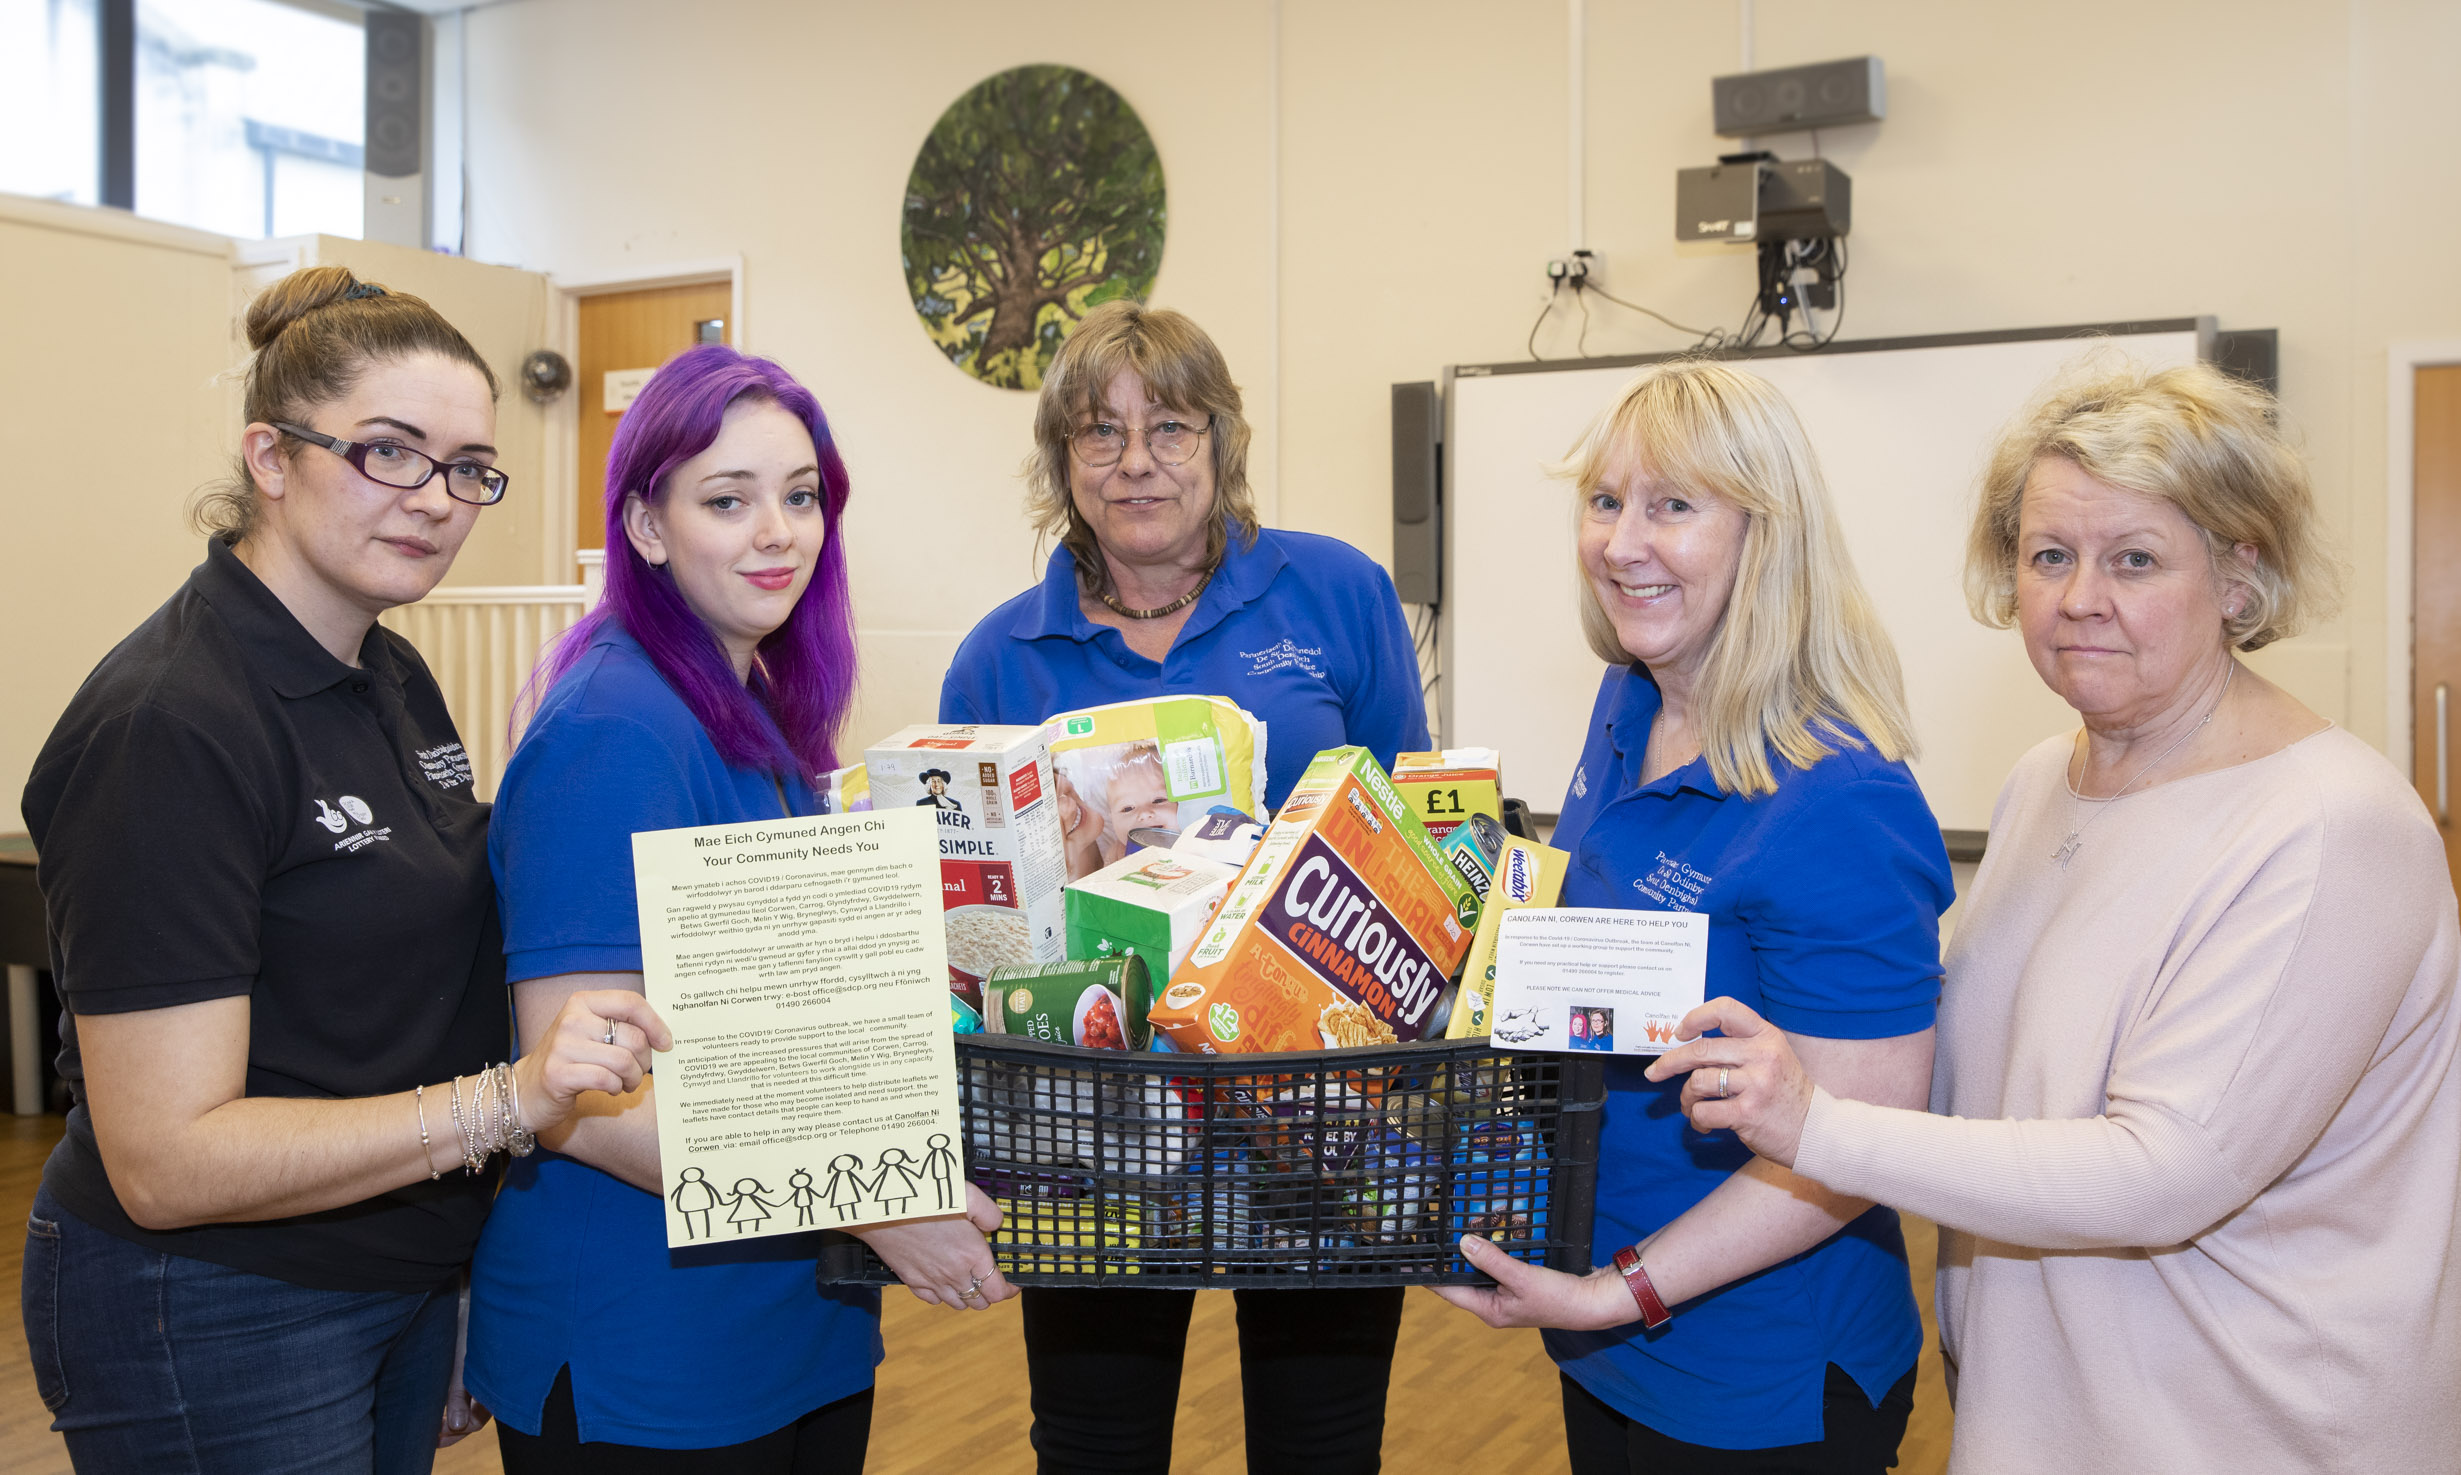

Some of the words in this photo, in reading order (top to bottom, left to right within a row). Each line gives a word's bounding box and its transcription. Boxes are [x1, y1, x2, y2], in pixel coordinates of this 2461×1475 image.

[1427, 789, 1465, 814] £1
[334, 832, 364, 851] ARIENNIR
[348, 836, 376, 853] LOTTERY
[694, 836, 721, 848] Mae
[724, 832, 753, 845] Eich
[755, 826, 817, 844] Cymuned
[820, 824, 861, 837] Angen
[864, 819, 885, 832] Chi
[702, 856, 733, 867] Your
[736, 848, 809, 864] Community
[812, 843, 853, 857] Needs
[855, 841, 879, 852] You
[1423, 834, 1445, 866] WHOLE
[1444, 865, 1463, 890] GRAIN
[1385, 837, 1425, 898] THE
[1511, 848, 1526, 904] Weetabix
[990, 893, 1008, 902] MINS
[991, 880, 1002, 894] 2
[1220, 912, 1246, 920] WATER
[1547, 915, 1557, 923] NI,
[1559, 915, 1594, 923] CORWEN
[1594, 916, 1611, 924] ARE
[1612, 917, 1634, 926] HERE
[1671, 920, 1688, 928] YOU
[1197, 948, 1224, 956] FRUIT
[1249, 943, 1262, 960] A
[672, 999, 719, 1012] Nghanolfan
[720, 997, 730, 1006] Ni
[730, 995, 762, 1004] Corwen
[763, 993, 784, 1001] trwy:
[785, 989, 811, 999] e-bost
[812, 983, 877, 996] office@sdcp.org
[894, 976, 930, 986] Ffôniwch
[680, 992, 692, 1000] Os
[693, 988, 724, 1000] gallwch
[725, 987, 738, 995] chi
[739, 985, 762, 994] helpu
[763, 983, 788, 991] mewn
[789, 979, 819, 988] unrhyw
[819, 975, 847, 985] ffordd,
[848, 970, 890, 983] cysylltwch
[897, 968, 905, 976] ni
[906, 968, 921, 977] yng
[775, 999, 801, 1010] 01490
[801, 996, 831, 1007] 266004
[683, 1036, 716, 1044] response
[738, 1029, 773, 1039] COVID19/
[774, 1025, 817, 1035] Coronavirus
[817, 1020, 851, 1030] outbreak,
[887, 1013, 906, 1022] small
[925, 1010, 933, 1018] of
[1216, 1004, 1237, 1032] 12
[692, 1096, 735, 1107] immediately
[735, 1094, 754, 1102] need
[775, 1088, 805, 1098] moment
[805, 1085, 842, 1095] volunteers
[867, 1078, 901, 1088] distribute
[902, 1075, 928, 1083] leaflets
[685, 1136, 691, 1144] If
[693, 1136, 708, 1145] you
[709, 1134, 723, 1142] are
[724, 1132, 742, 1140] able
[752, 1129, 771, 1137] help
[797, 1124, 813, 1132] way
[814, 1121, 841, 1131] please
[842, 1116, 873, 1127] contact
[884, 1114, 893, 1122] at
[894, 1110, 930, 1121] Canolfan
[930, 1108, 940, 1117] Ni
[687, 1144, 720, 1153] Corwen
[722, 1141, 737, 1150] via:
[738, 1138, 761, 1147] email
[761, 1132, 828, 1145] office@sdcp.org
[838, 1125, 880, 1136] Telephone
[880, 1121, 906, 1131] 01490
[906, 1118, 938, 1128] 266004.
[1343, 1131, 1357, 1143] BY
